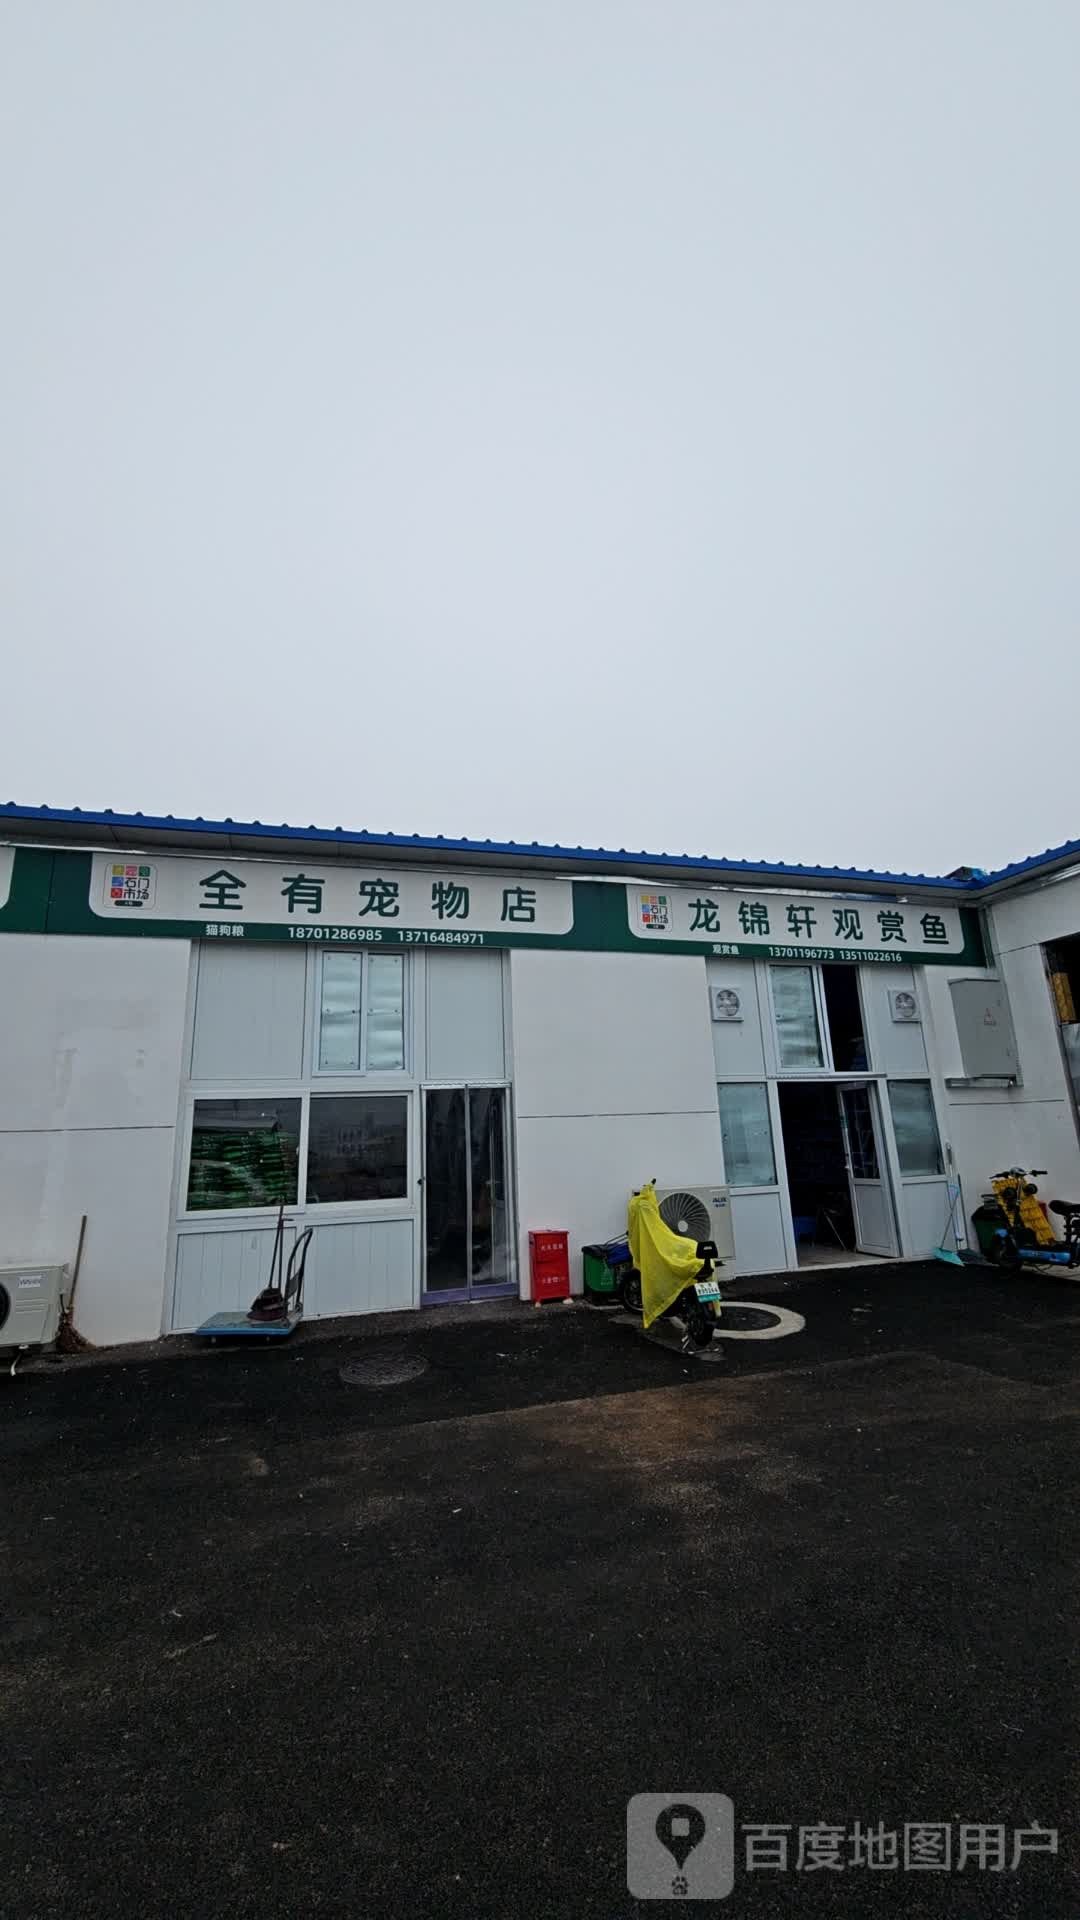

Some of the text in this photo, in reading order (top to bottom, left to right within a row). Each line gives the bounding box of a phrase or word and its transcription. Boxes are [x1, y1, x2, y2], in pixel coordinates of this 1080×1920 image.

[124, 877, 150, 888] 石门
[123, 888, 150, 900] 市场
[199, 869, 537, 923] 全有宠物店
[688, 898, 950, 945] 龙锦轩观赏鱼
[205, 924, 245, 937] 猫狗粮
[288, 927, 484, 944] 18701286985 13716484971
[712, 944, 740, 955] 观赏鱼
[768, 946, 902, 962] 13701196773 13511022616
